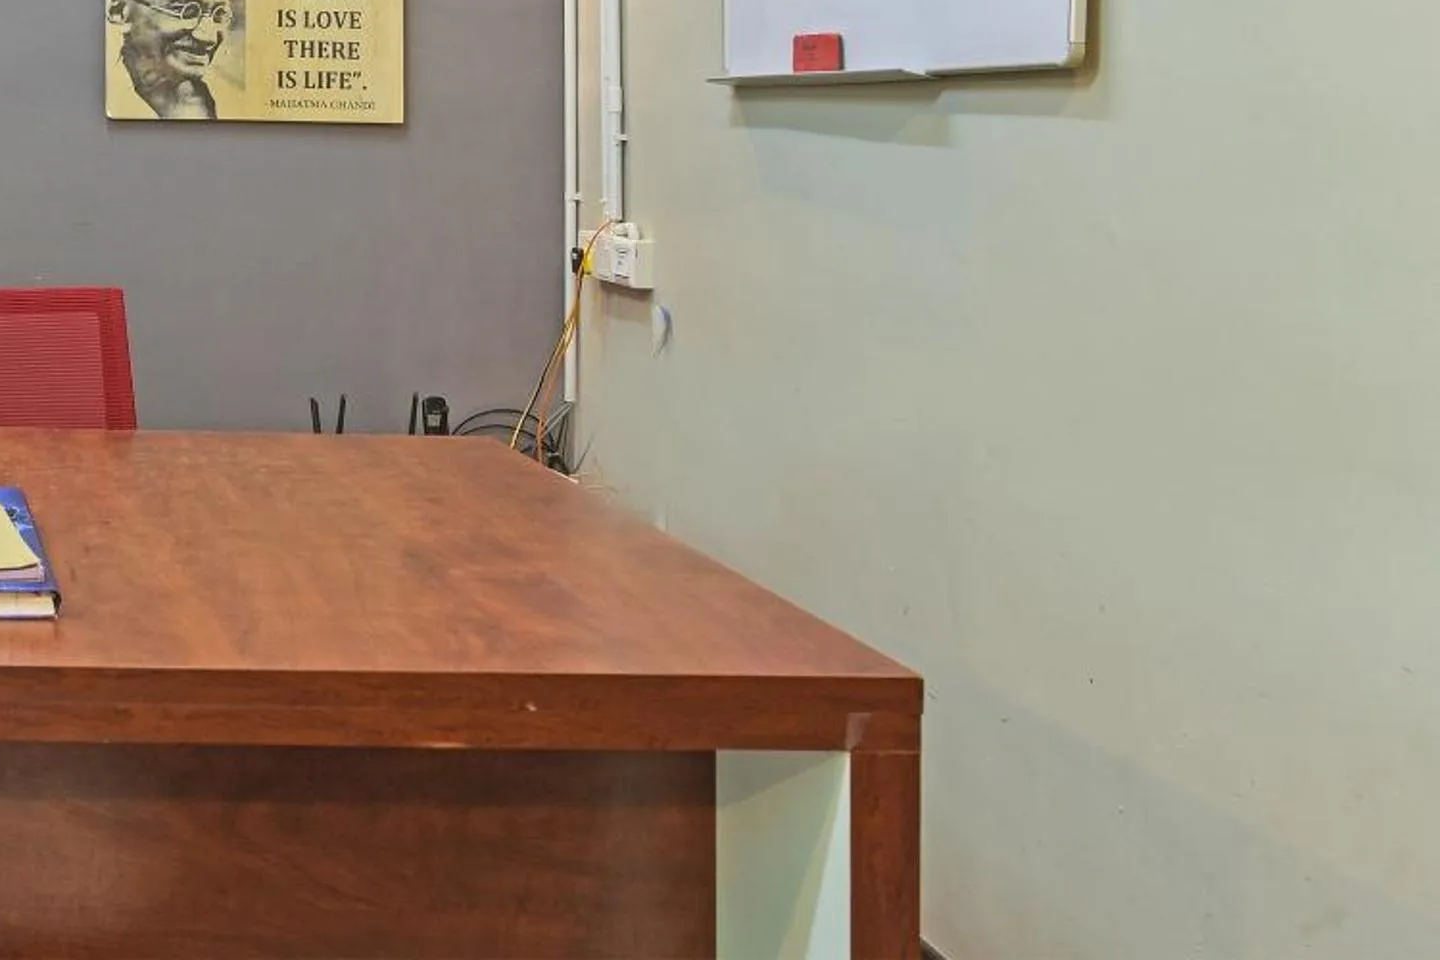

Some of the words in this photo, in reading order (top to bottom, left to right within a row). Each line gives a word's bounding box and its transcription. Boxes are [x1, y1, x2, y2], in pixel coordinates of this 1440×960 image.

[276, 8, 297, 29] IS
[304, 10, 362, 30] LOVE
[283, 39, 361, 60] THERE
[276, 70, 297, 89] IS
